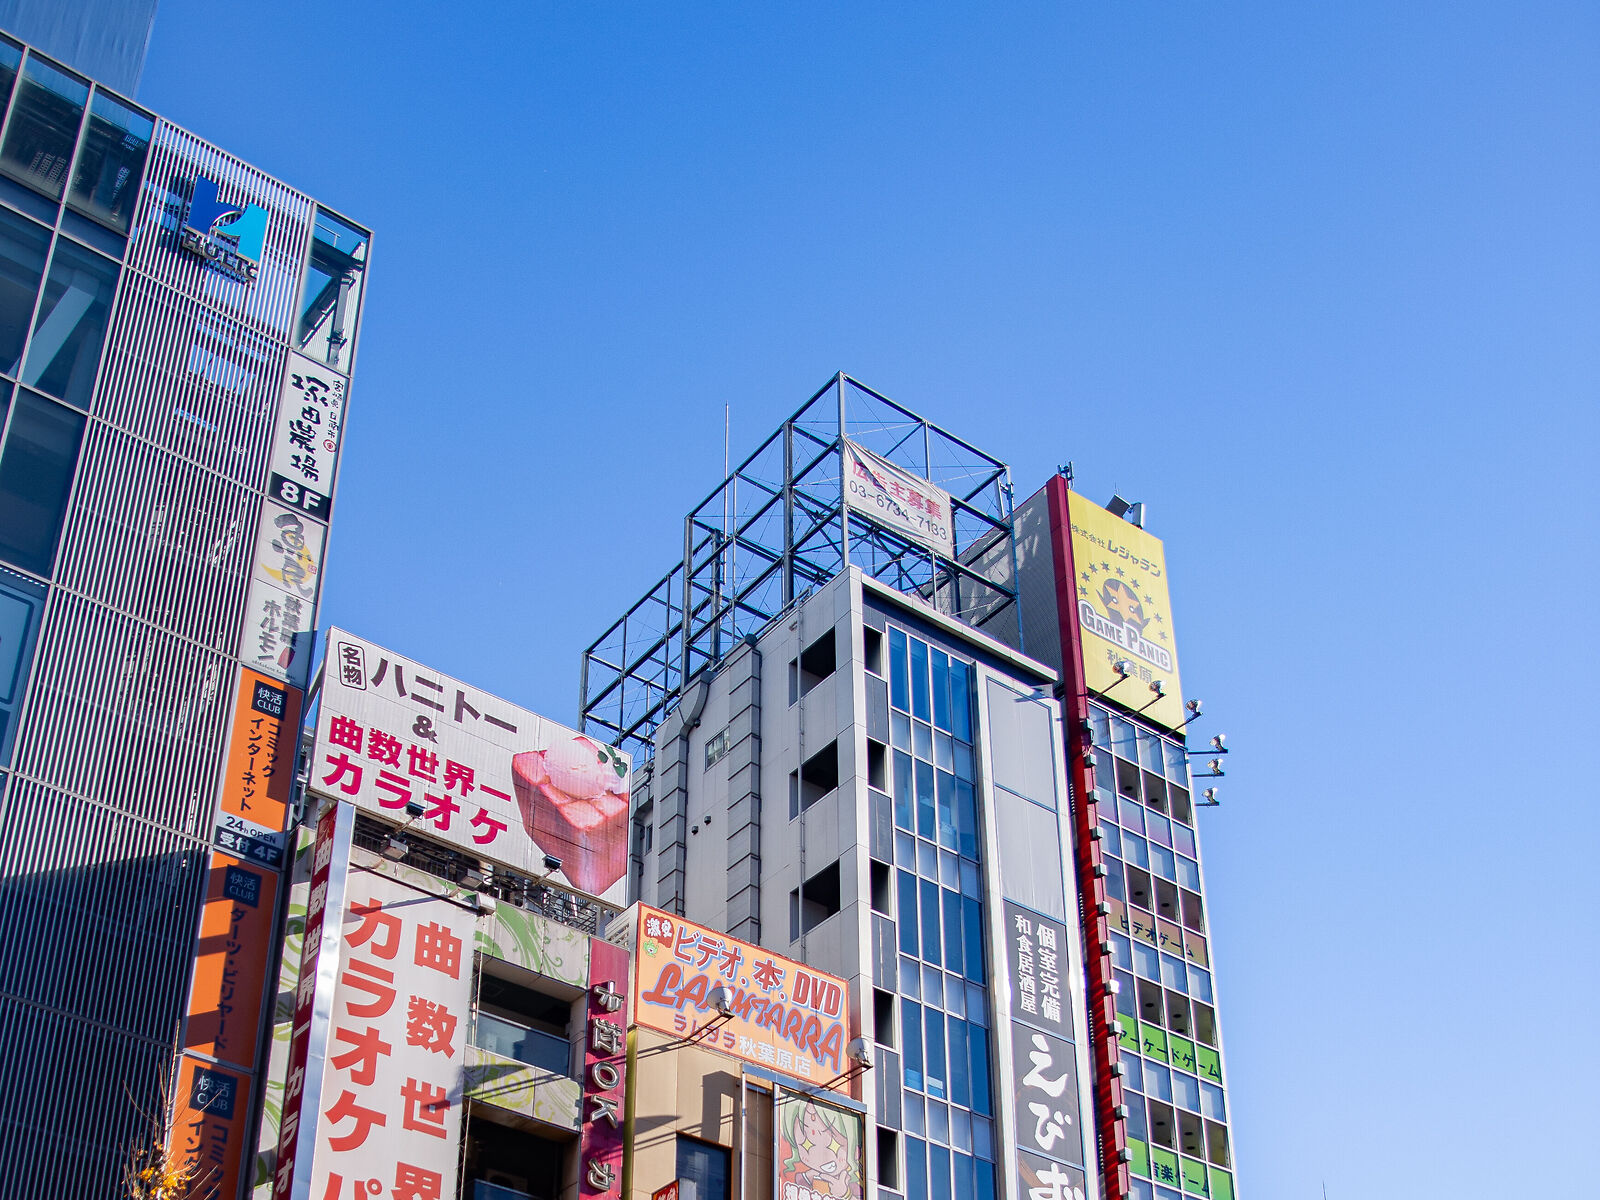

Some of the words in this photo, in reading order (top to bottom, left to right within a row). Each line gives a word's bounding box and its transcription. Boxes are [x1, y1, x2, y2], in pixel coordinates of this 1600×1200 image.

[280, 481, 321, 511] 8F
[1107, 538, 1161, 578] レジャラン
[256, 600, 281, 661] ホルモン
[1080, 602, 1123, 645] GAME
[1124, 622, 1170, 669] PANIC
[257, 700, 281, 715] CLUB
[258, 687, 283, 706] 快活
[342, 646, 362, 686] 名物
[370, 657, 518, 734] ハニトー
[262, 721, 282, 778] コミック
[412, 714, 438, 744] &
[240, 718, 264, 812] インターネット
[327, 714, 512, 804] 曲数世界一
[321, 751, 508, 845] カラオケ
[219, 832, 251, 852] 受付
[254, 844, 278, 862] 4F
[250, 828, 277, 845] OPEN
[229, 871, 256, 891] 快活
[229, 884, 255, 901] CLUB
[1119, 914, 1195, 959] ビデオゲーム
[1015, 913, 1038, 1015] 和食居酒屋
[1036, 922, 1062, 1024] 個室完備
[738, 1036, 812, 1077] 秋葉原店
[1118, 1030, 1220, 1080] アーケードゲーム
[197, 1092, 228, 1111] CLUB
[198, 1075, 230, 1098] 快活
